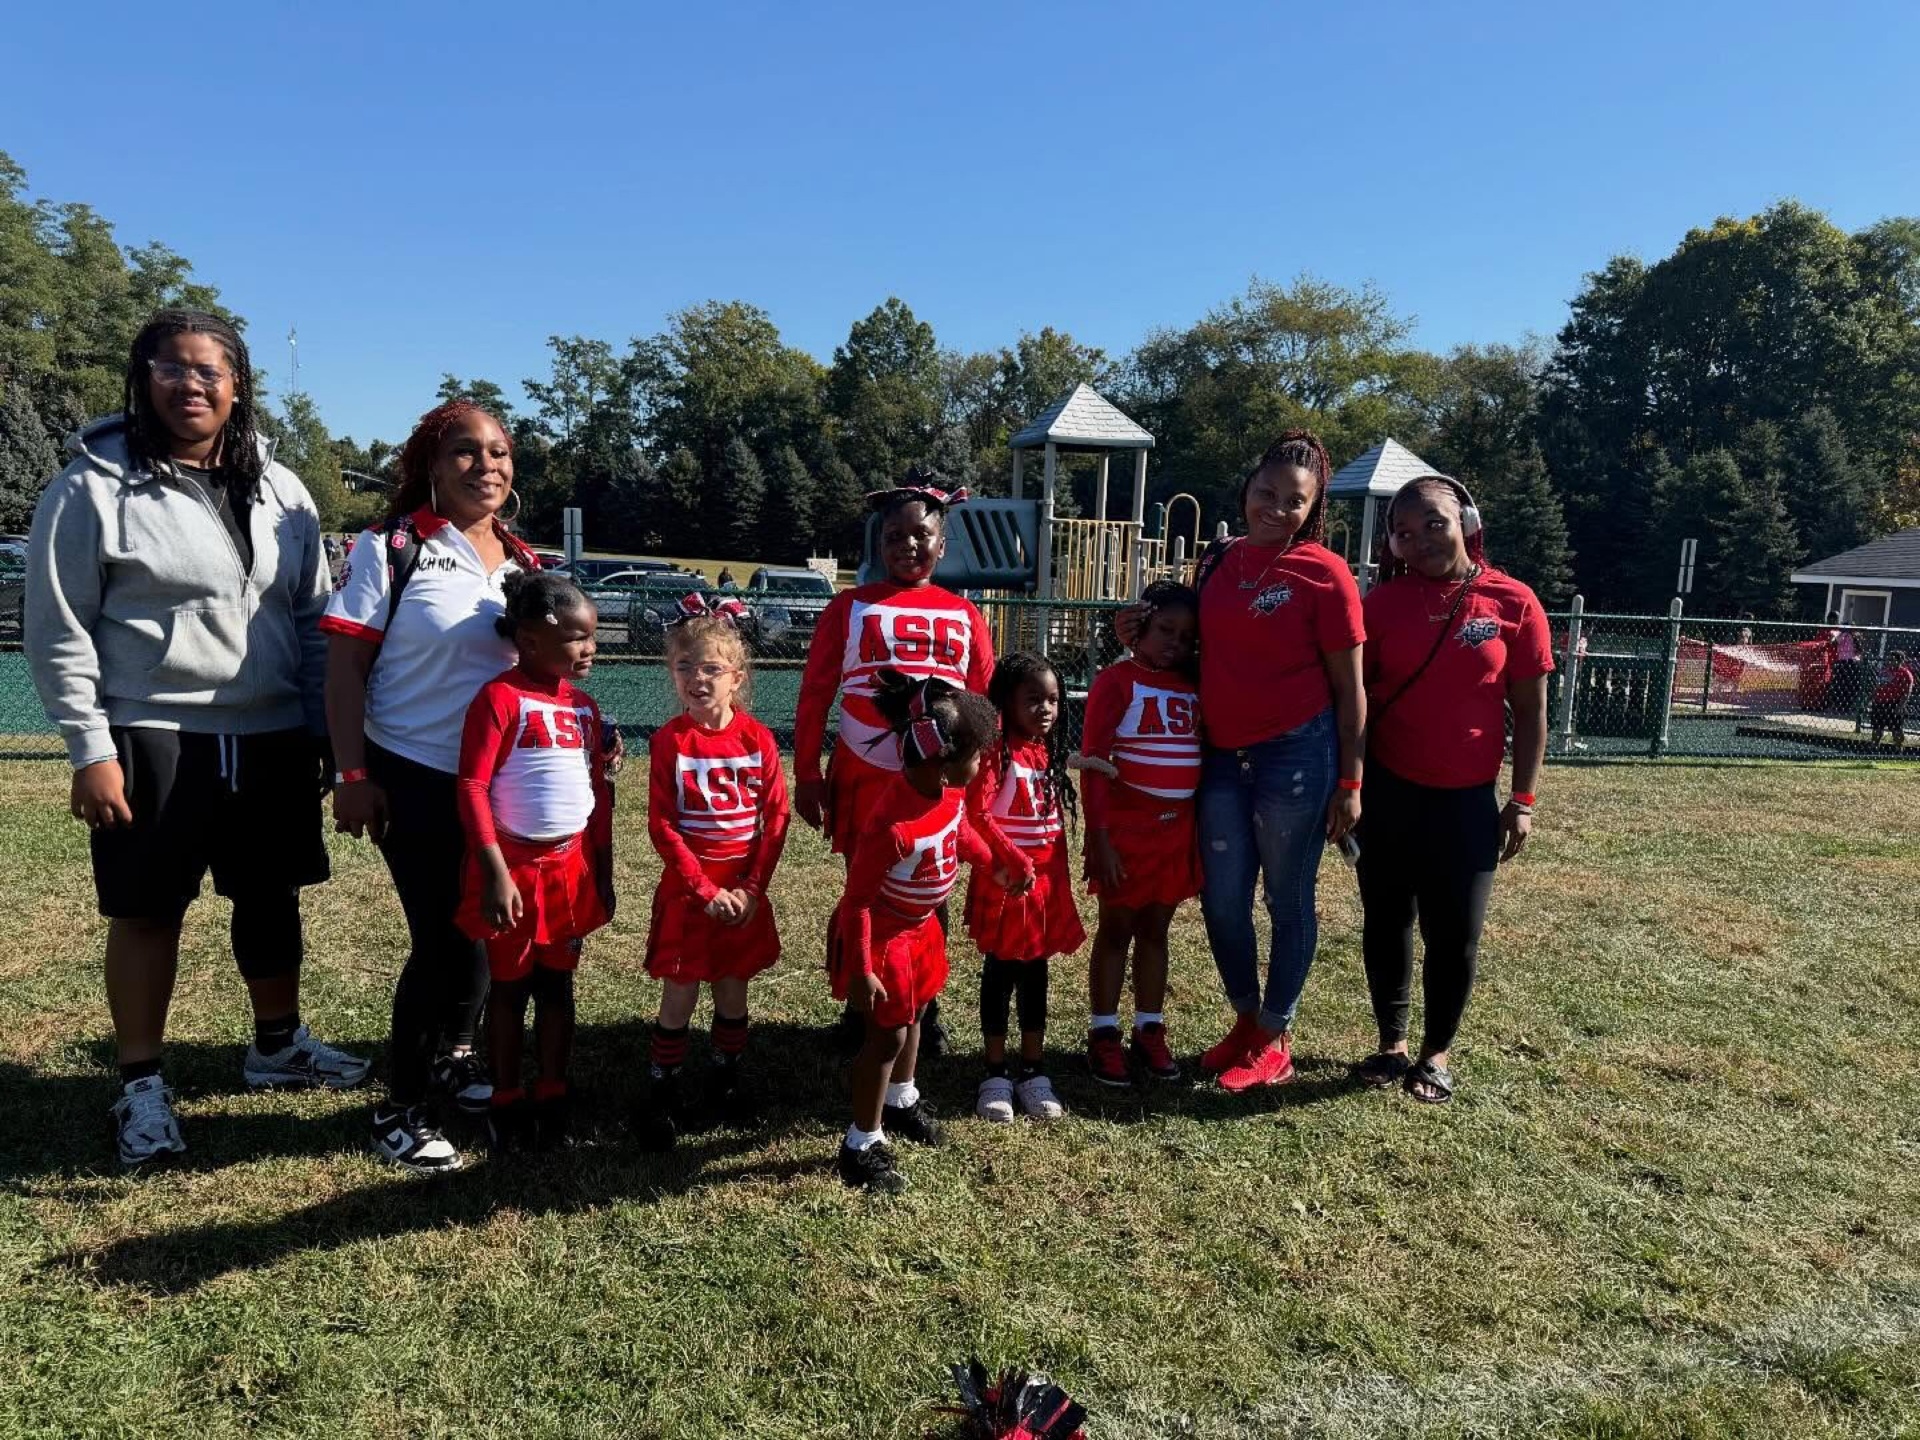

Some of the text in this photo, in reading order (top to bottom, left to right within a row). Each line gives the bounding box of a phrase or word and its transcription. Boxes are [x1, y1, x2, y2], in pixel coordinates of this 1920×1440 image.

[438, 556, 457, 572] NIA
[859, 613, 965, 666] ASG
[681, 766, 763, 811] ASG
